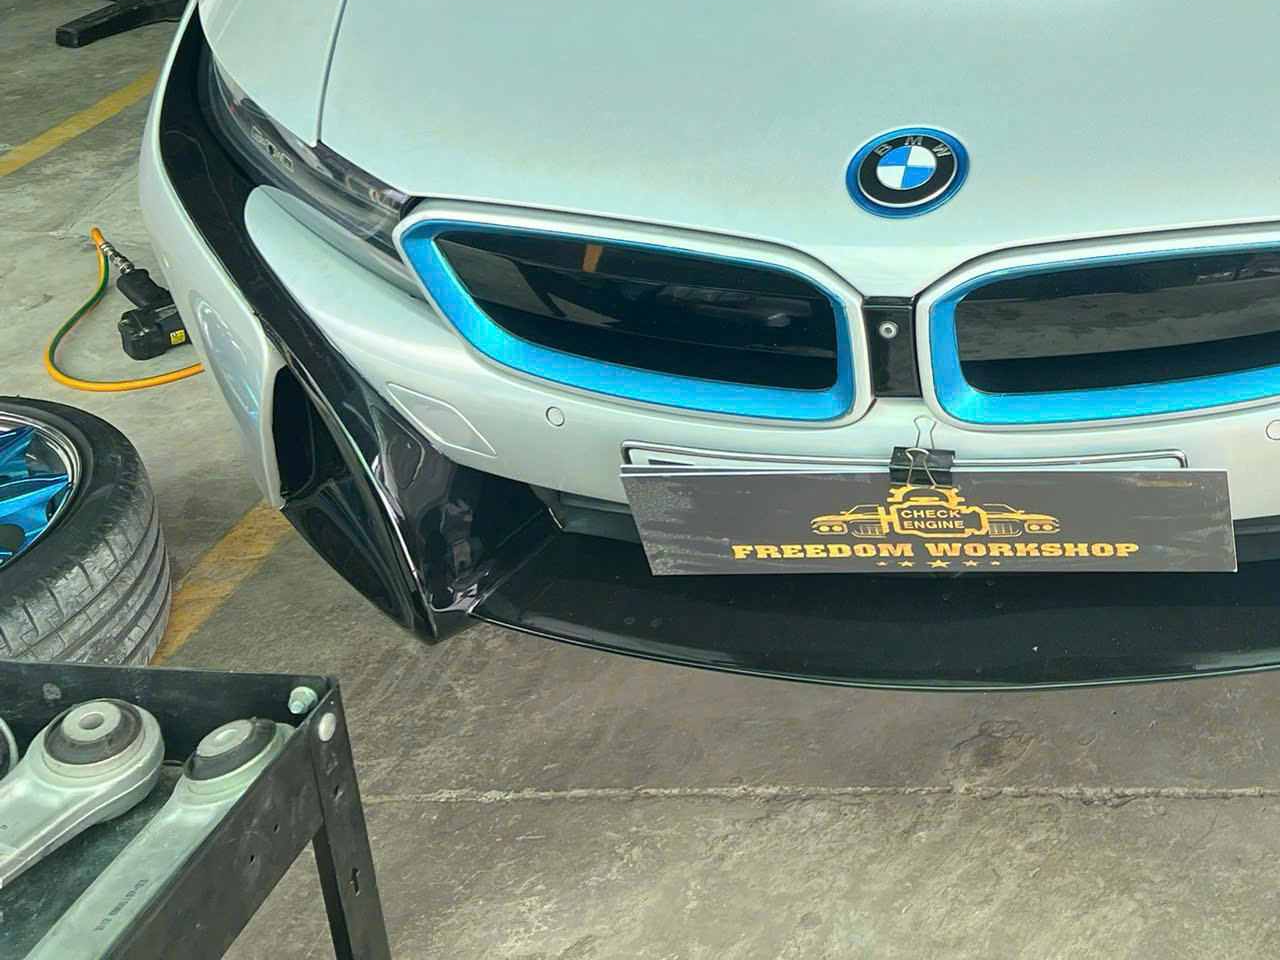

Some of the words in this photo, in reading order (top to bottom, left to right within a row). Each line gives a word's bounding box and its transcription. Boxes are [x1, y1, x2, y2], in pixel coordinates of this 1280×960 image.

[874, 135, 952, 158] BMW
[900, 509, 961, 519] CHECK
[903, 520, 965, 530] ENGINE
[731, 542, 915, 560] FREEDOM
[925, 542, 1140, 557] WORKSHOP
